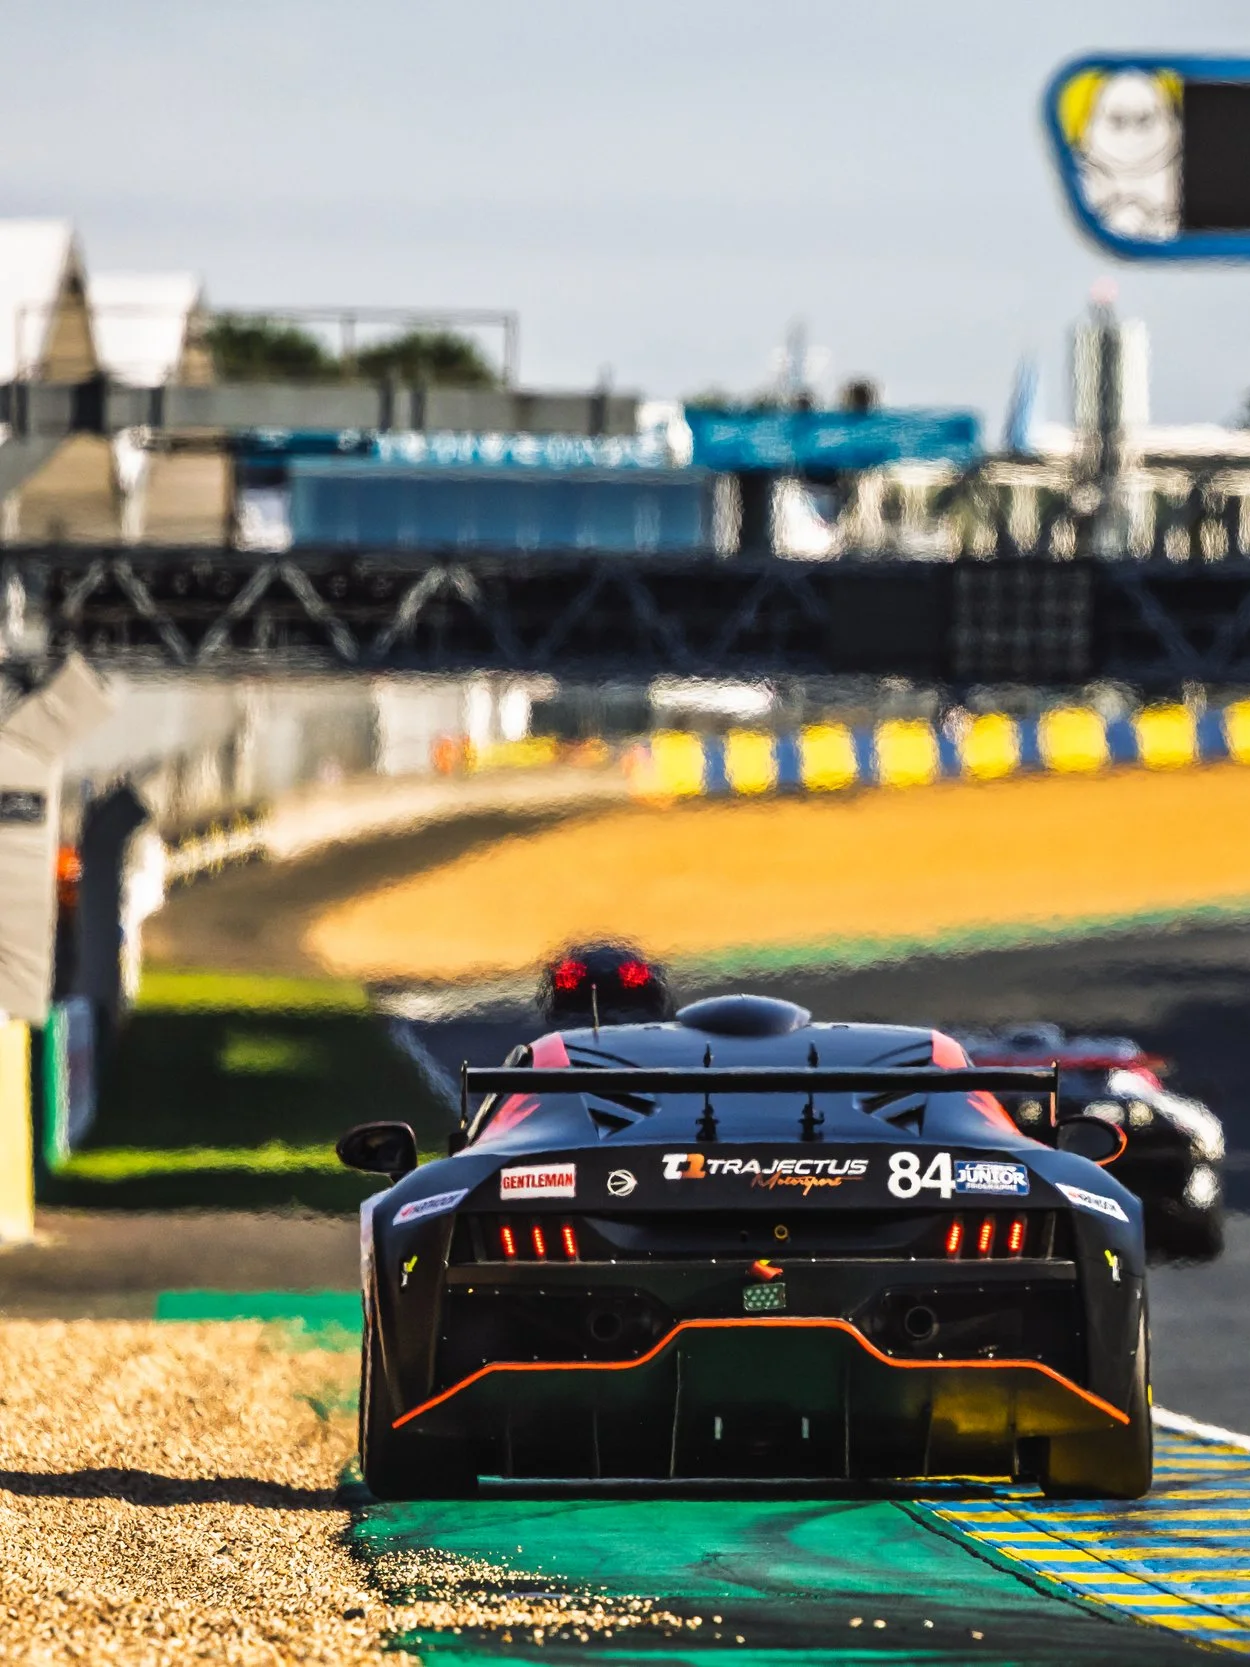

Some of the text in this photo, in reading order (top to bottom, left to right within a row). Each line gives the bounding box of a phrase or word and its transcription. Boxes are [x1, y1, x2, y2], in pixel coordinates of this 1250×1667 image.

[707, 1159, 869, 1175] TRAJECTUS
[887, 1151, 955, 1199] 84
[503, 1173, 574, 1189] GENTLEMAN
[751, 1170, 863, 1196] Motorsport
[957, 1169, 1027, 1186] JUNIOR
